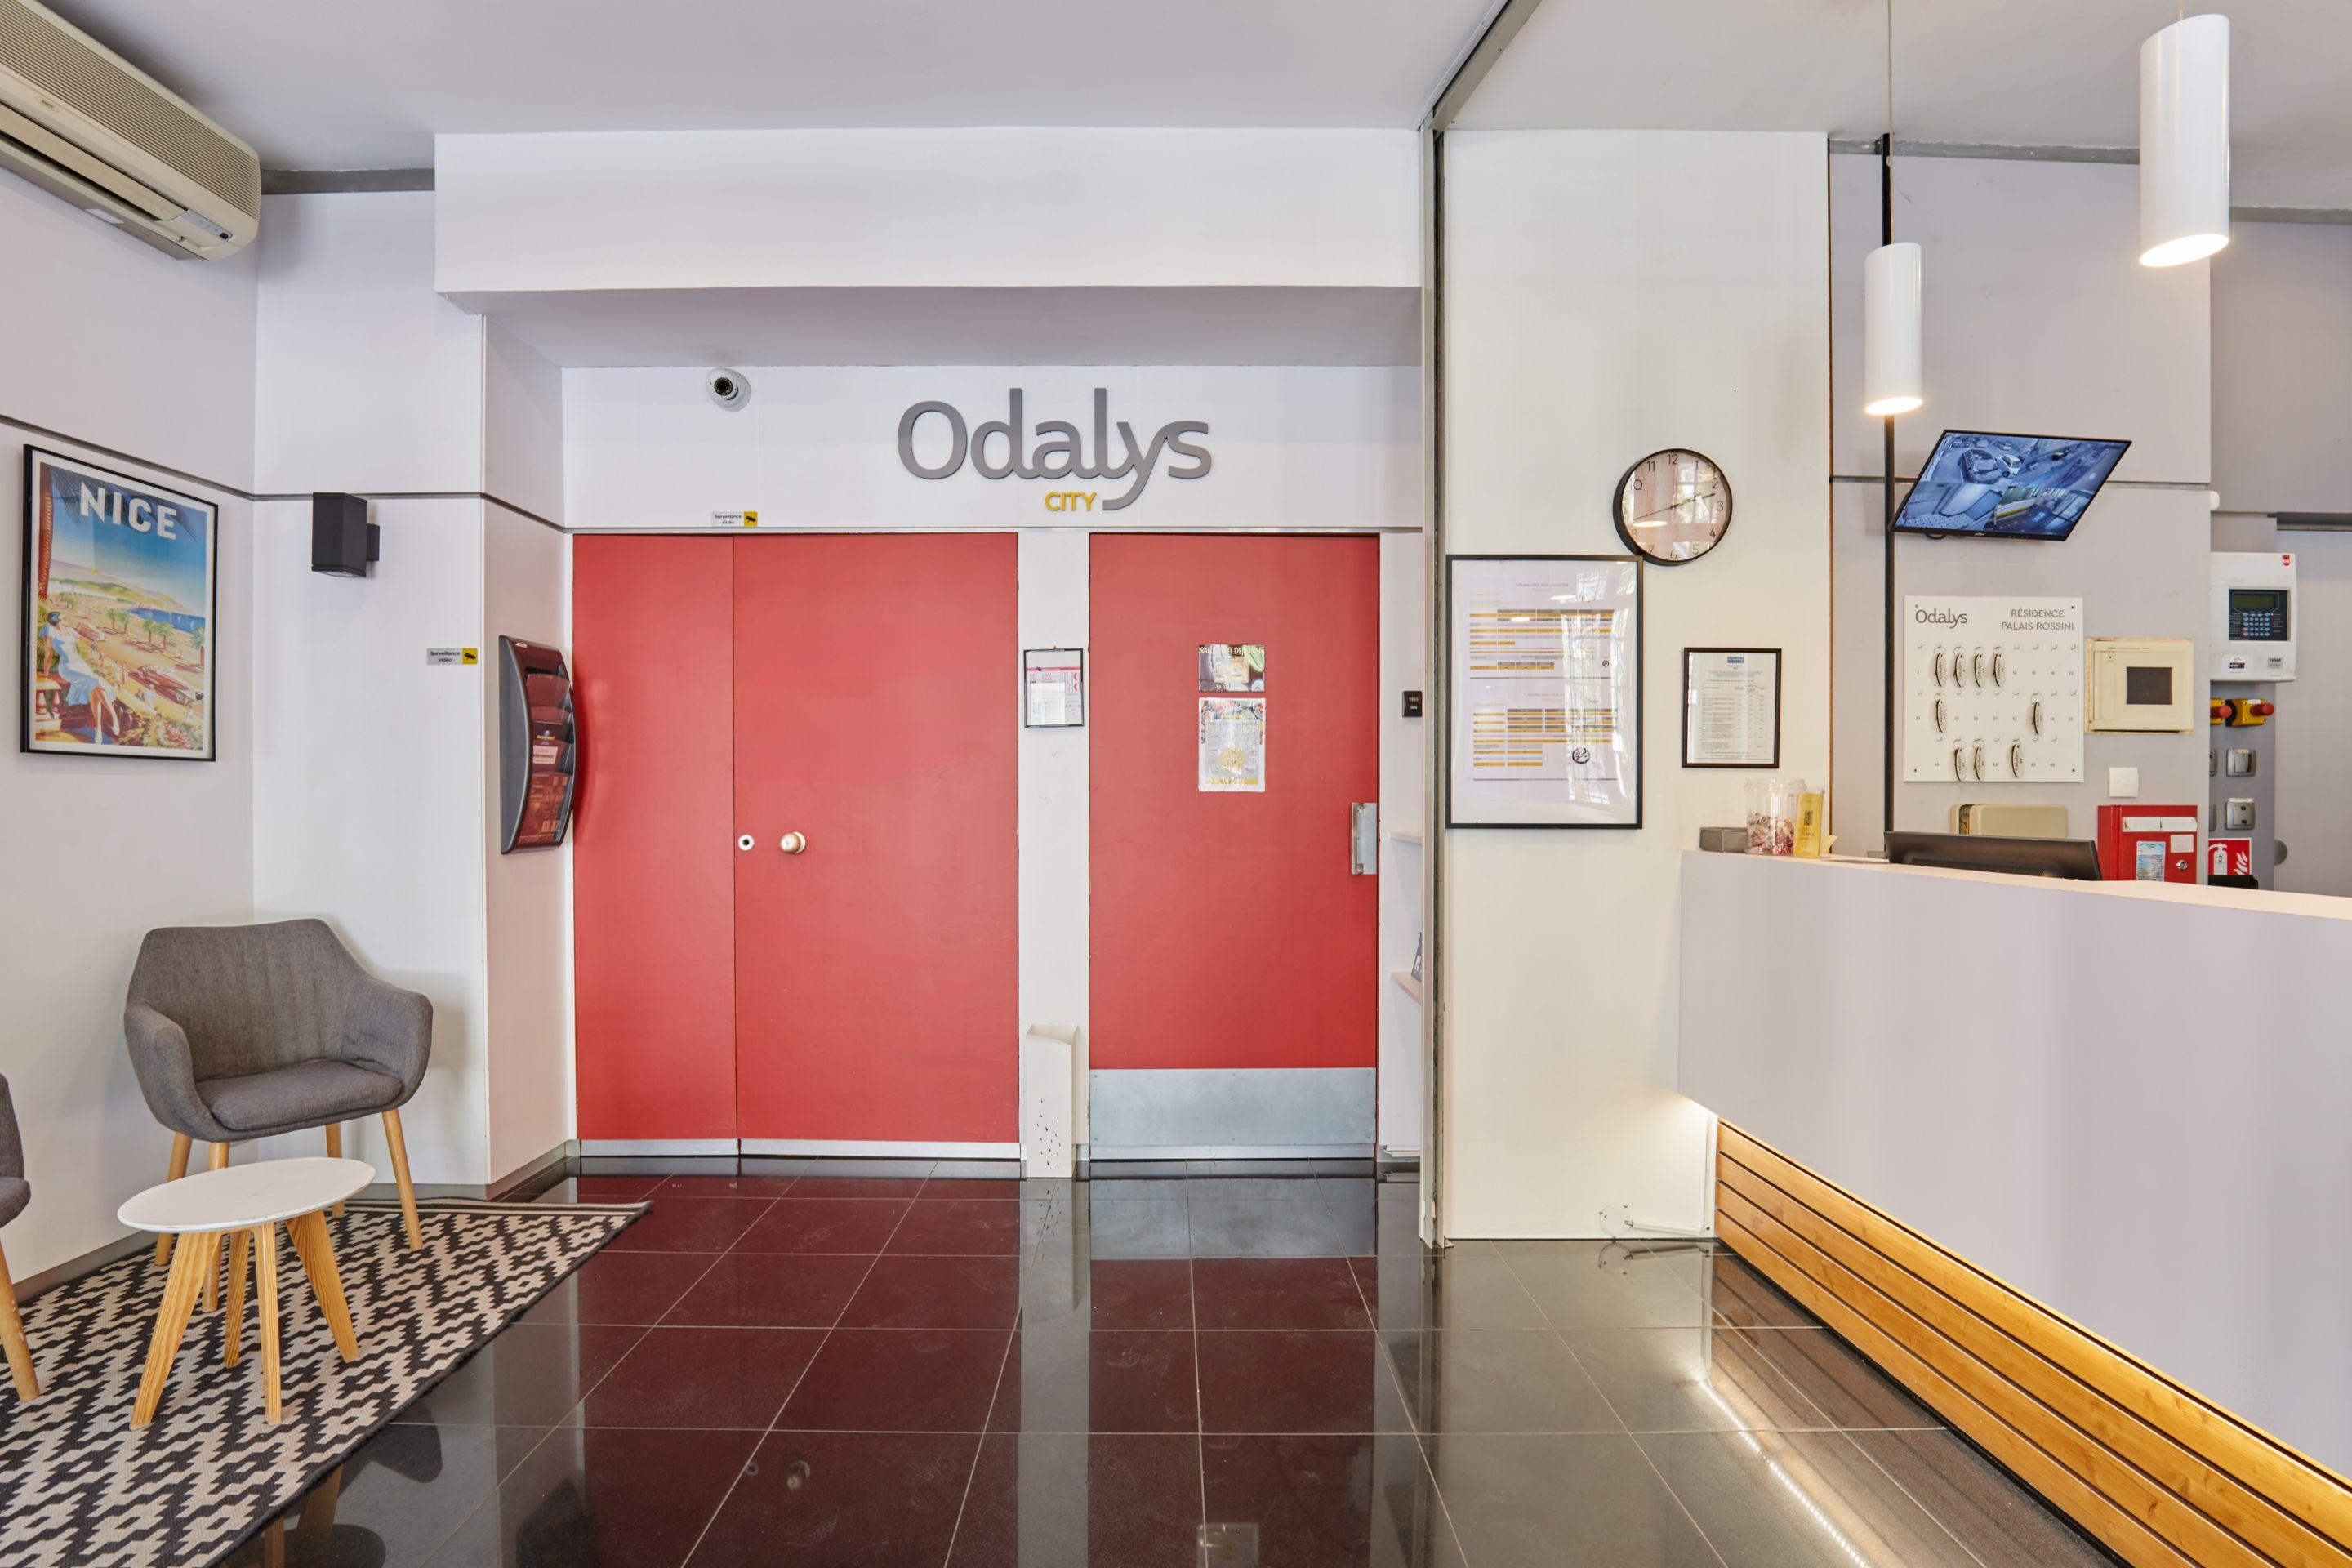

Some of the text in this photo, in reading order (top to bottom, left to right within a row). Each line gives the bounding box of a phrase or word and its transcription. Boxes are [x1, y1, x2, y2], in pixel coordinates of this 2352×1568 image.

[897, 387, 1213, 511] Odalys
[1667, 453, 1678, 466] 12
[1646, 461, 1655, 472] 11
[1712, 478, 1718, 489] 2
[1044, 492, 1097, 511] CITY
[1717, 500, 1724, 512] 3
[79, 480, 179, 541] NICE
[1631, 528, 1638, 540] 8
[1709, 528, 1716, 538] 4
[1648, 545, 1655, 555] 7
[1670, 549, 1677, 560] 6
[1692, 545, 1699, 555] 5
[2011, 607, 2065, 618] RÉSIDENCE
[1915, 608, 1968, 629] Odalys
[2001, 621, 2074, 631] PALAIS ROSSINI
